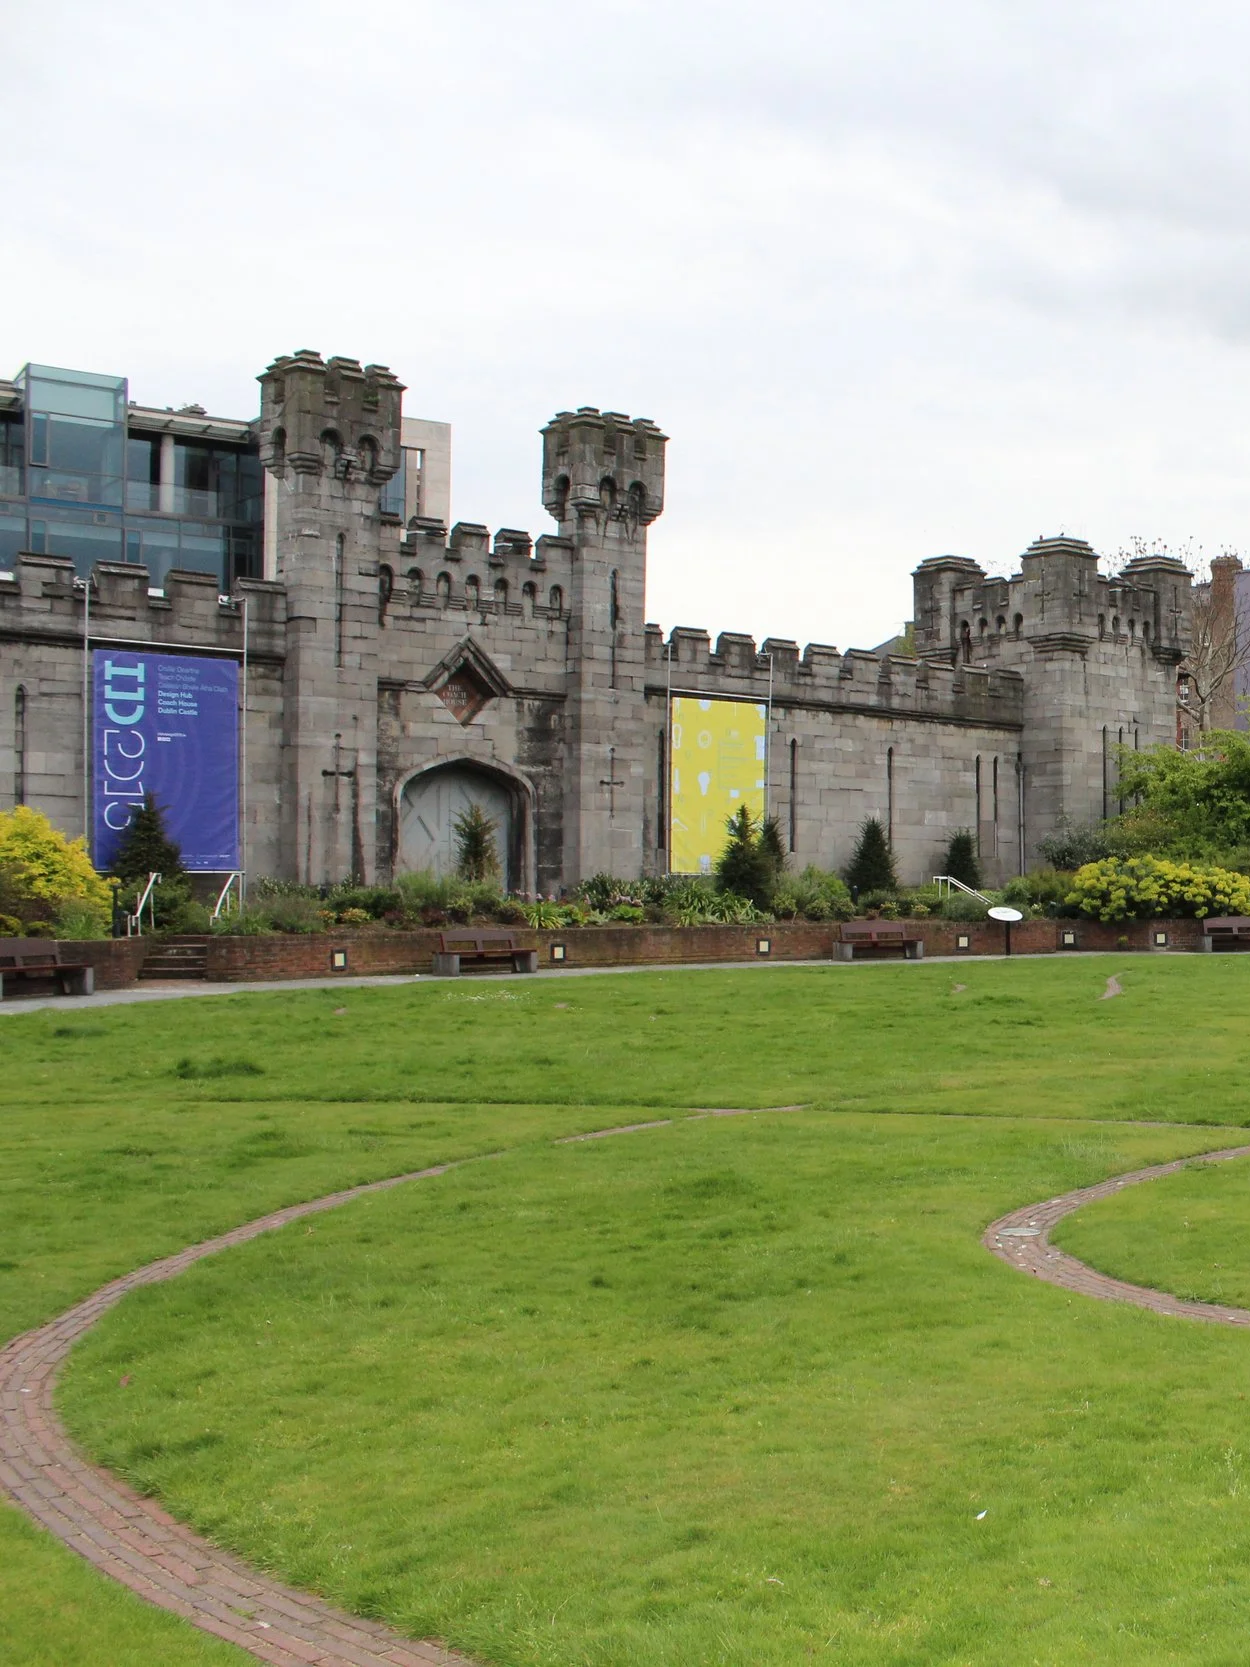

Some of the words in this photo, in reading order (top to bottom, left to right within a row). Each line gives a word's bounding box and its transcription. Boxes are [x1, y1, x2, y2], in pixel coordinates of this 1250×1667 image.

[448, 684, 463, 692] THE
[157, 690, 180, 699] Design
[180, 691, 193, 699] Hub
[442, 691, 467, 699] COACH
[157, 698, 178, 706] Coach
[178, 708, 198, 716] Castle
